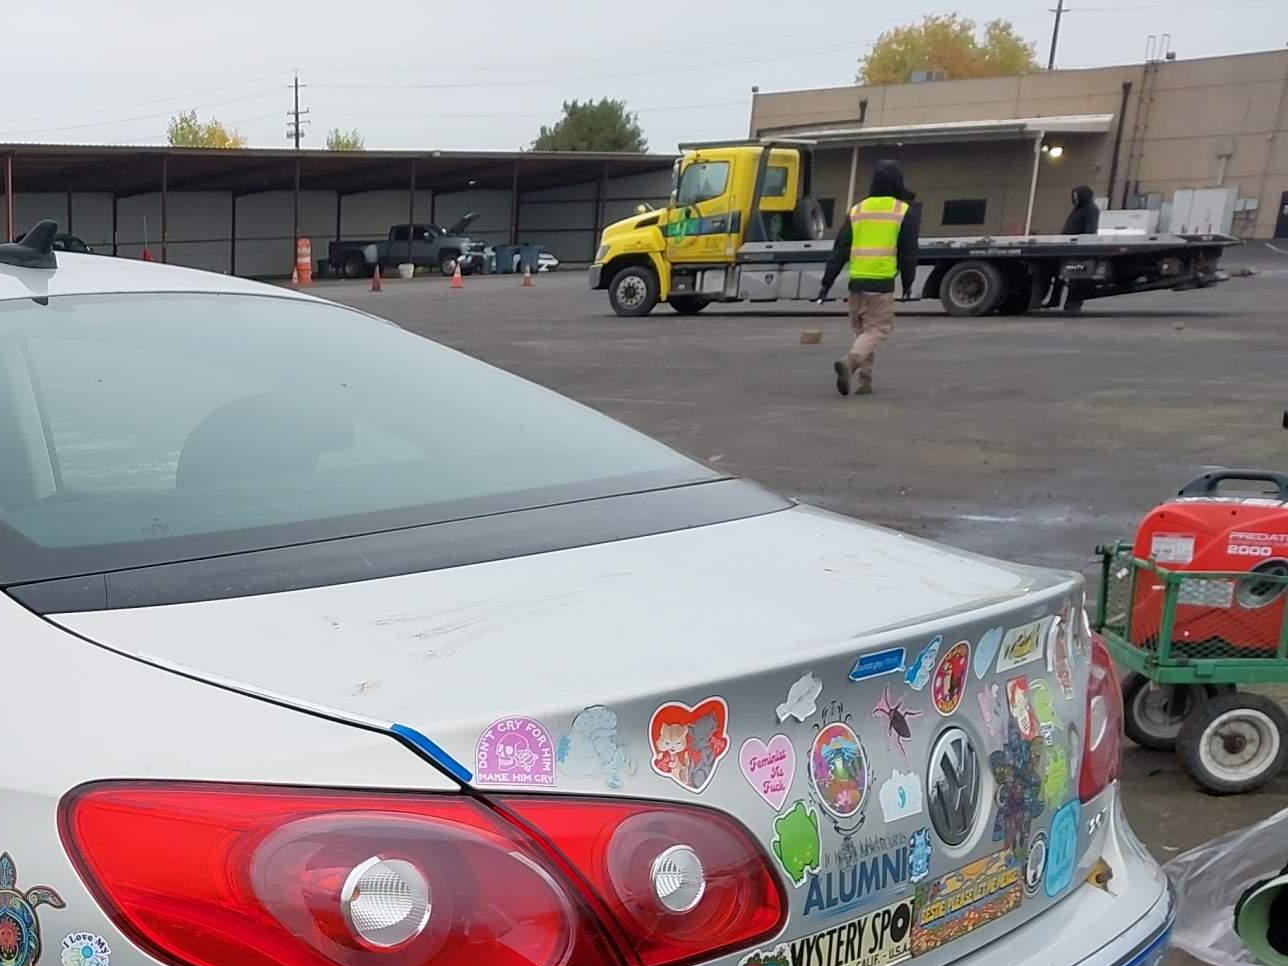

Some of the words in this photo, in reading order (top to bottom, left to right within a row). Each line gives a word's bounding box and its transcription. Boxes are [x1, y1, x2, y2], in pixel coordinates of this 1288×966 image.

[1229, 531, 1288, 543] PREDAT
[1227, 544, 1272, 556] 2000
[478, 730, 496, 769] DON'T
[497, 719, 523, 732] CRY
[525, 723, 547, 747] FOR
[541, 747, 552, 772] HIM
[749, 748, 787, 772] Feminist
[478, 773, 510, 782] MAKE
[513, 773, 531, 782] HIM
[534, 774, 553, 784] CRY
[763, 780, 786, 795] Fuck
[802, 846, 908, 916] ALUMNI
[62, 940, 70, 948] I
[69, 933, 94, 944] Love
[95, 937, 110, 954] My
